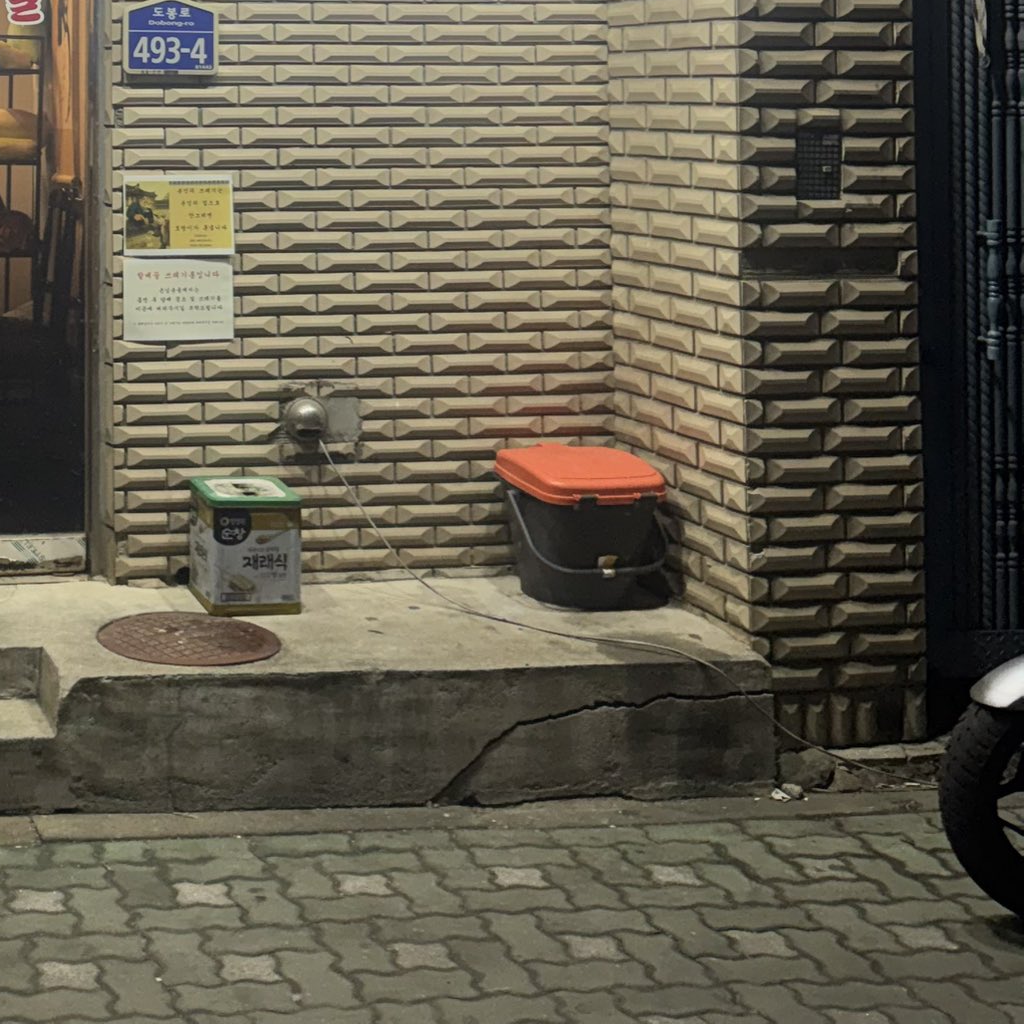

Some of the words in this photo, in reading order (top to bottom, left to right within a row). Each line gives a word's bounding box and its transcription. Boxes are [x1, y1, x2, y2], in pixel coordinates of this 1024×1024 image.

[152, 7, 191, 20] 도봉로
[133, 36, 207, 64] 493-4
[221, 528, 246, 540] 순창
[242, 553, 288, 570] 재래식
